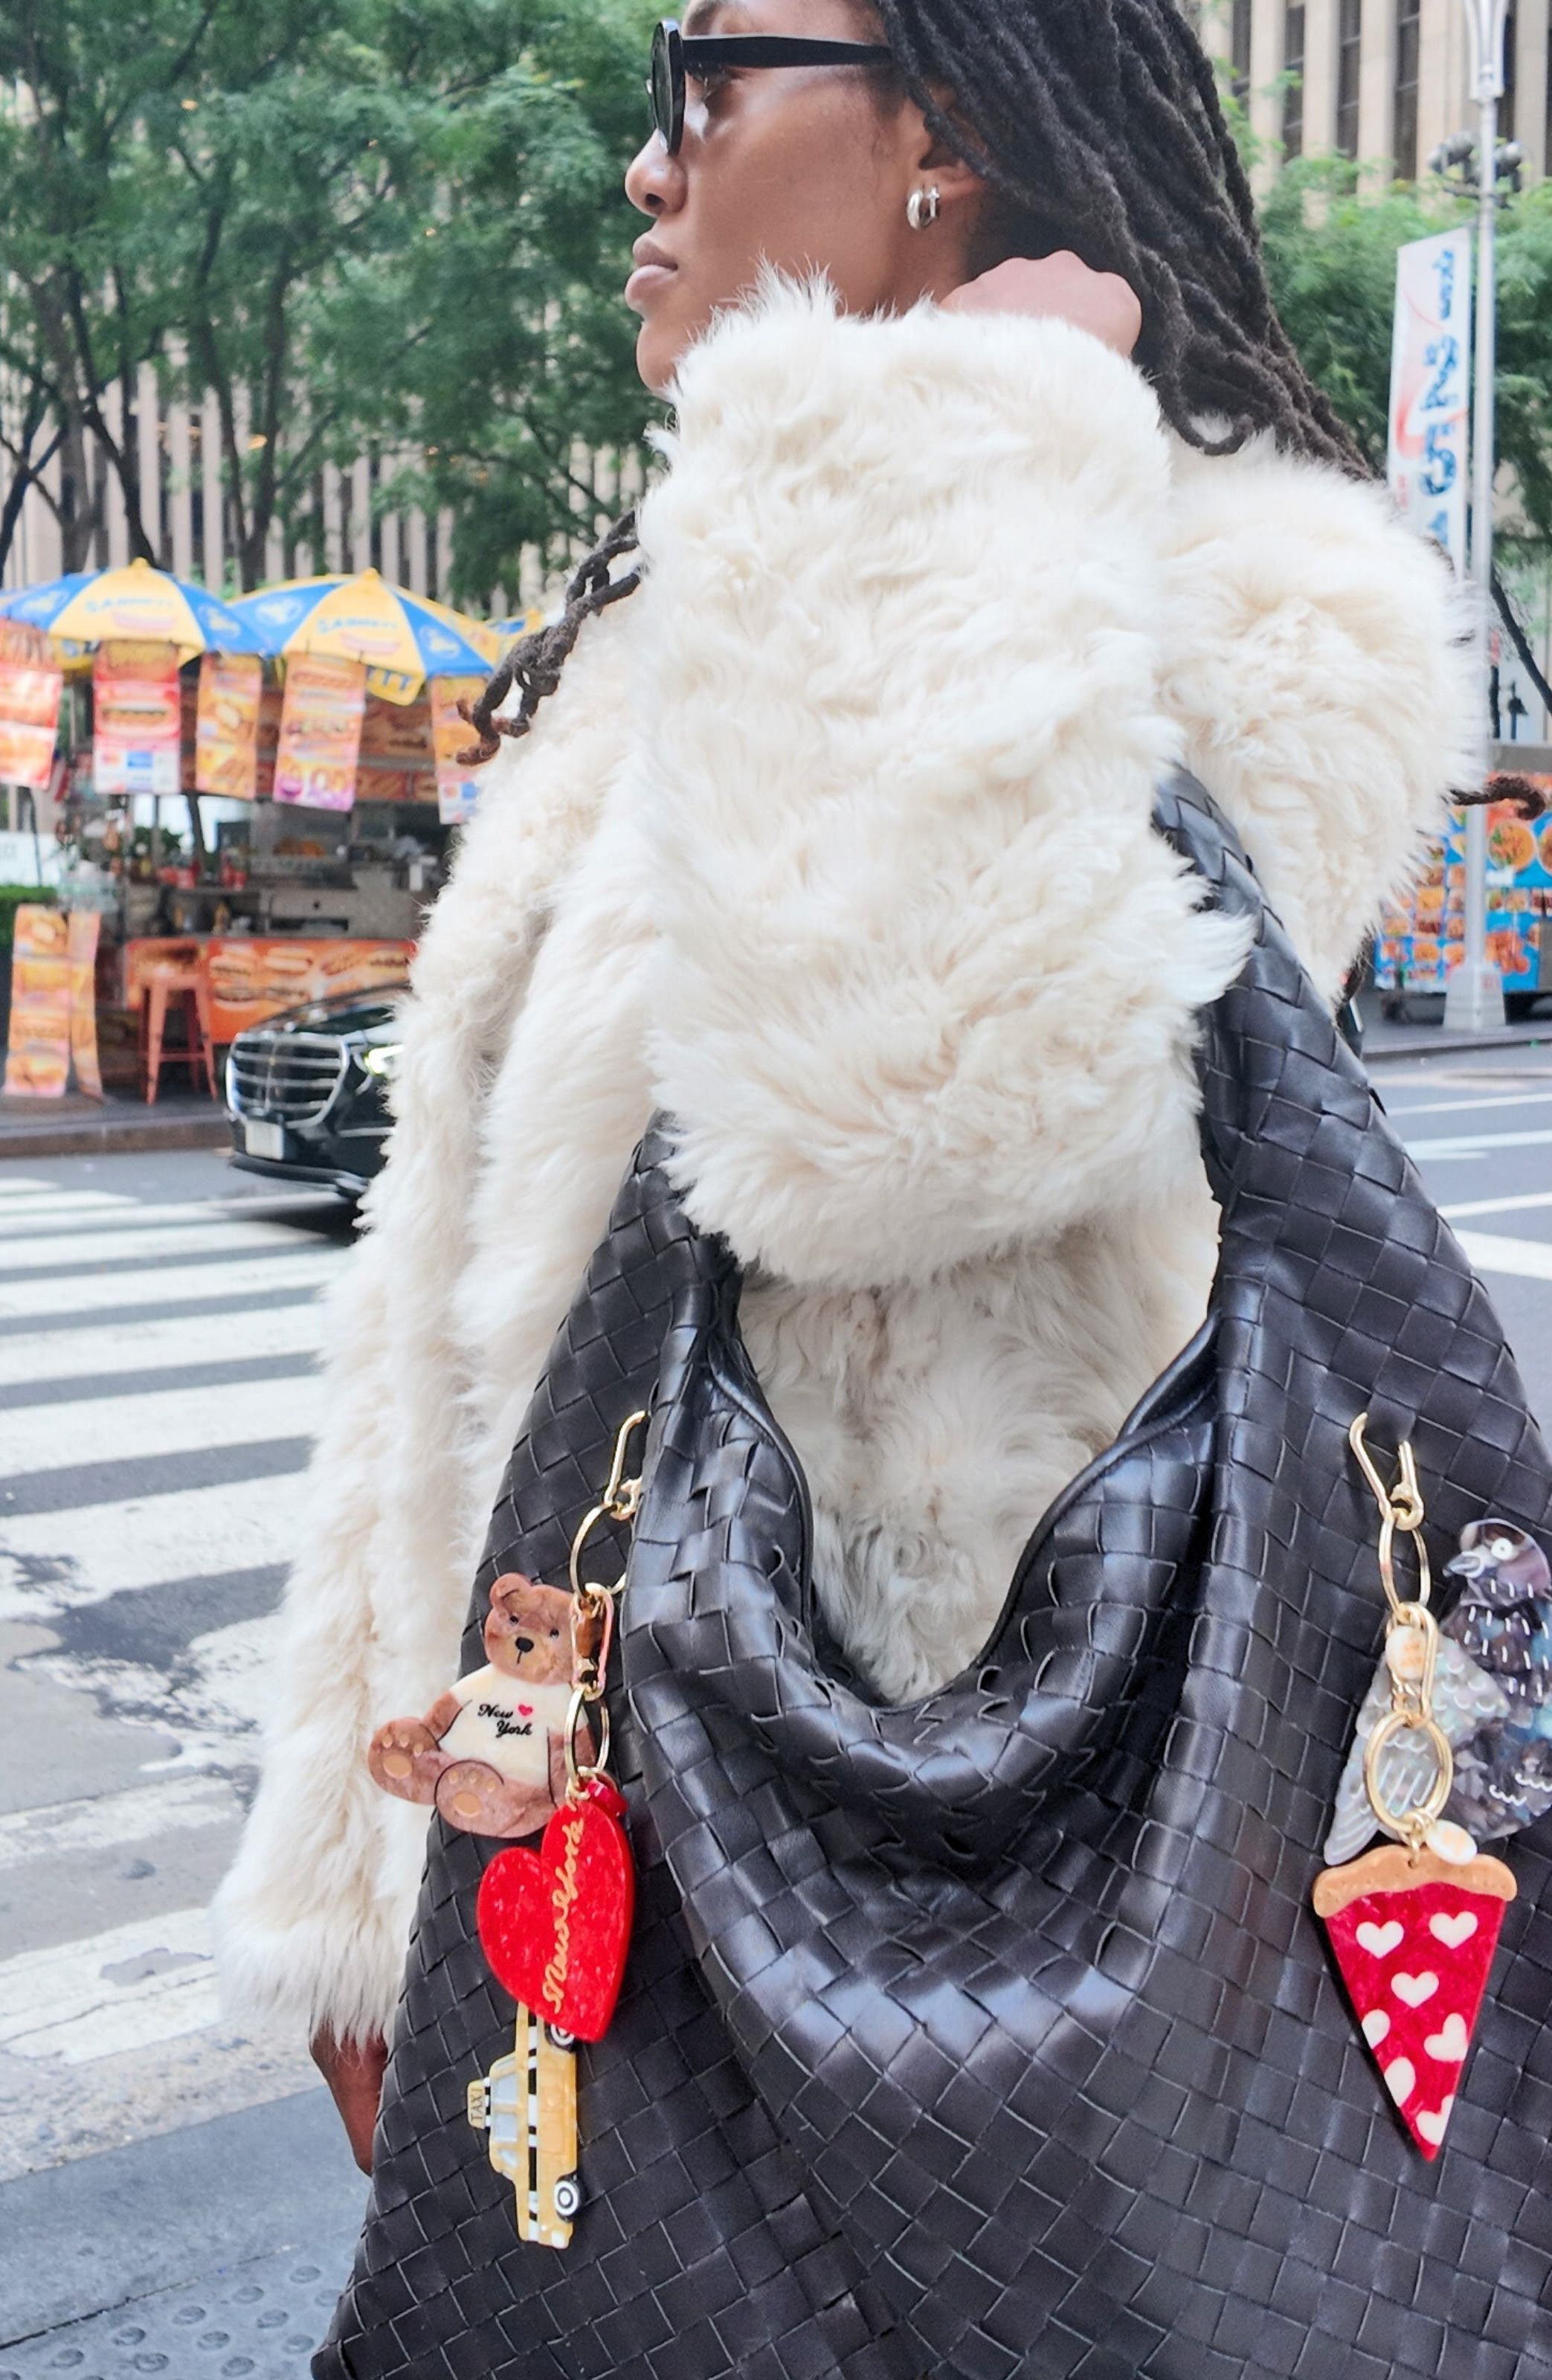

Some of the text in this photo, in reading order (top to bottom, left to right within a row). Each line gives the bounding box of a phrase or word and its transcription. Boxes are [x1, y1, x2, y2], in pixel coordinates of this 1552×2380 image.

[477, 1703, 514, 1719] New
[495, 1720, 532, 1738] York
[469, 2088, 483, 2123] TAXI
